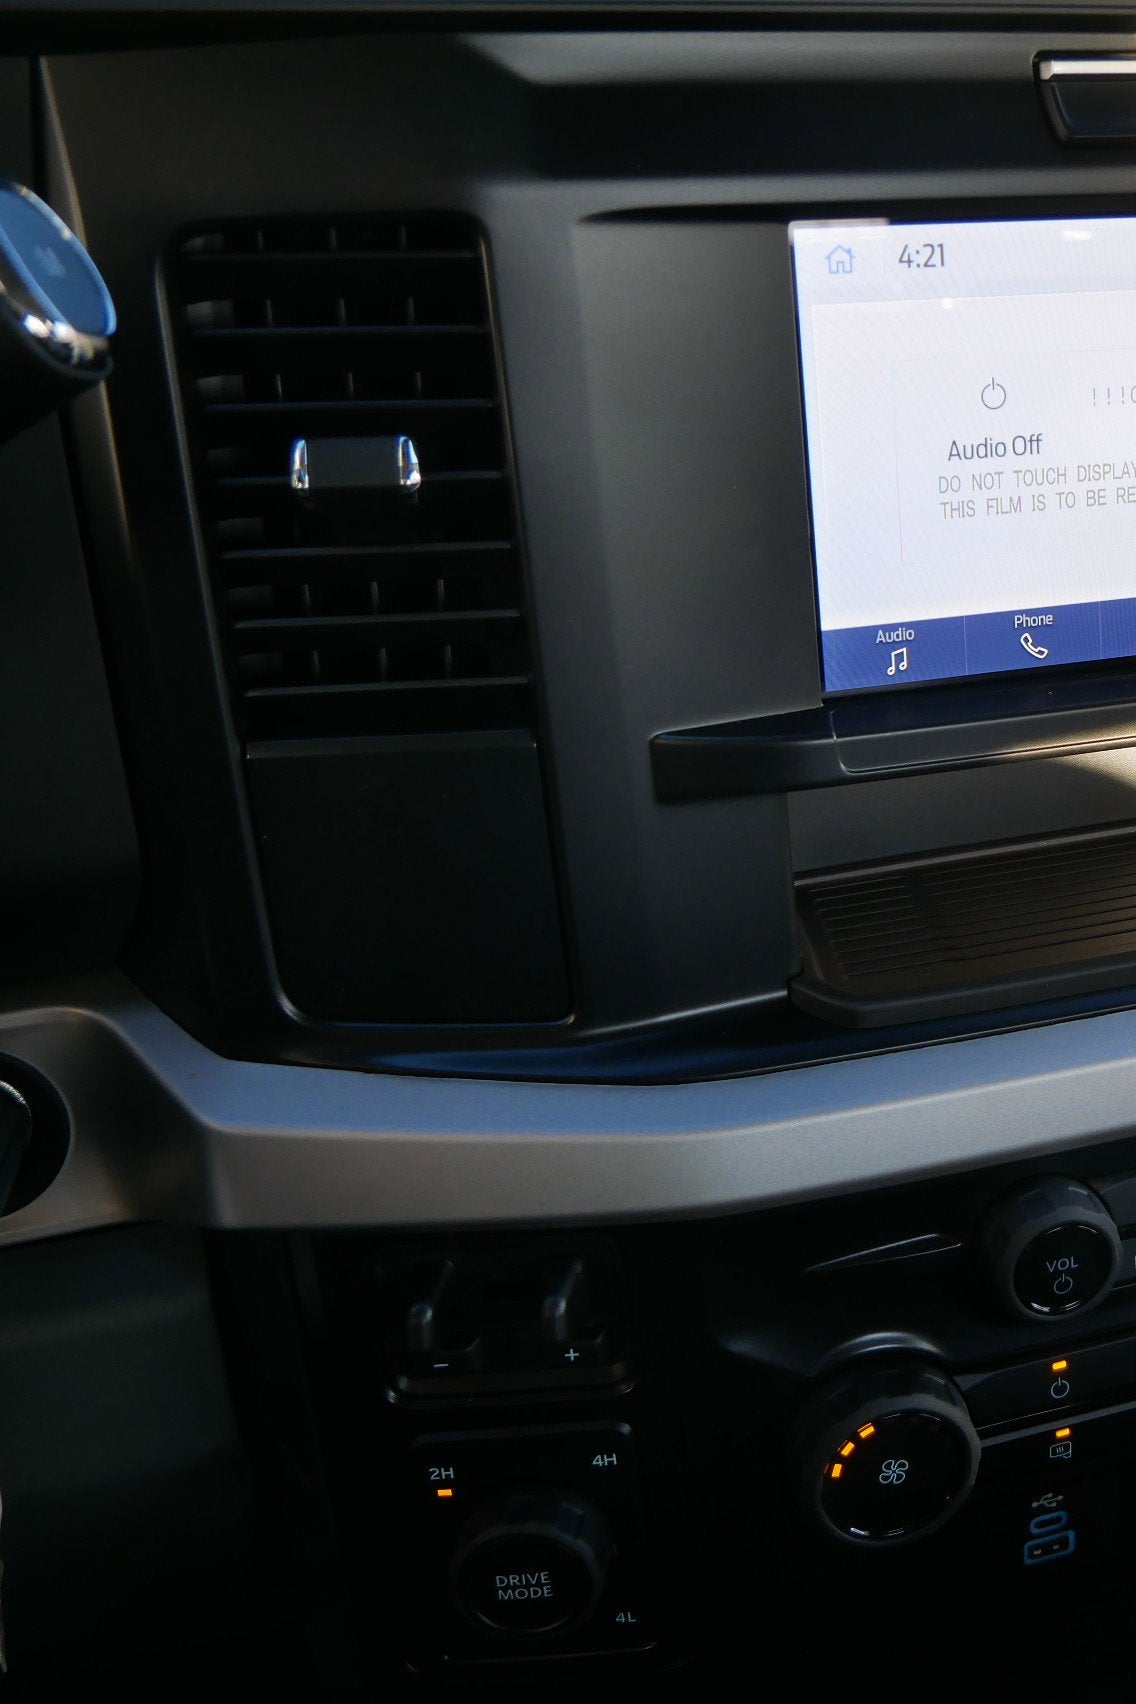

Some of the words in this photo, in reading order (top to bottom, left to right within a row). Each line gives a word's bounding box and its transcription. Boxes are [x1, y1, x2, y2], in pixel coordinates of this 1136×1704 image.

[898, 243, 945, 269] 4:21
[947, 437, 1007, 461] Audio
[1012, 433, 1043, 456] Off
[938, 475, 961, 494] DO
[971, 471, 1004, 491] NOT
[1013, 466, 1067, 488] TOUCH
[940, 500, 976, 519] THIS
[986, 496, 1022, 516] FILM
[1031, 494, 1046, 512] IS
[1055, 491, 1076, 509] TO
[1086, 488, 1107, 507] BE
[1014, 613, 1053, 629] Phone
[875, 627, 915, 644] Audio
[1046, 1256, 1079, 1273] VOL
[592, 1453, 618, 1467] 4H
[429, 1467, 455, 1481] 2H
[495, 1571, 551, 1588] DRIVE
[498, 1585, 554, 1601] MODE
[615, 1611, 637, 1624] 4L
